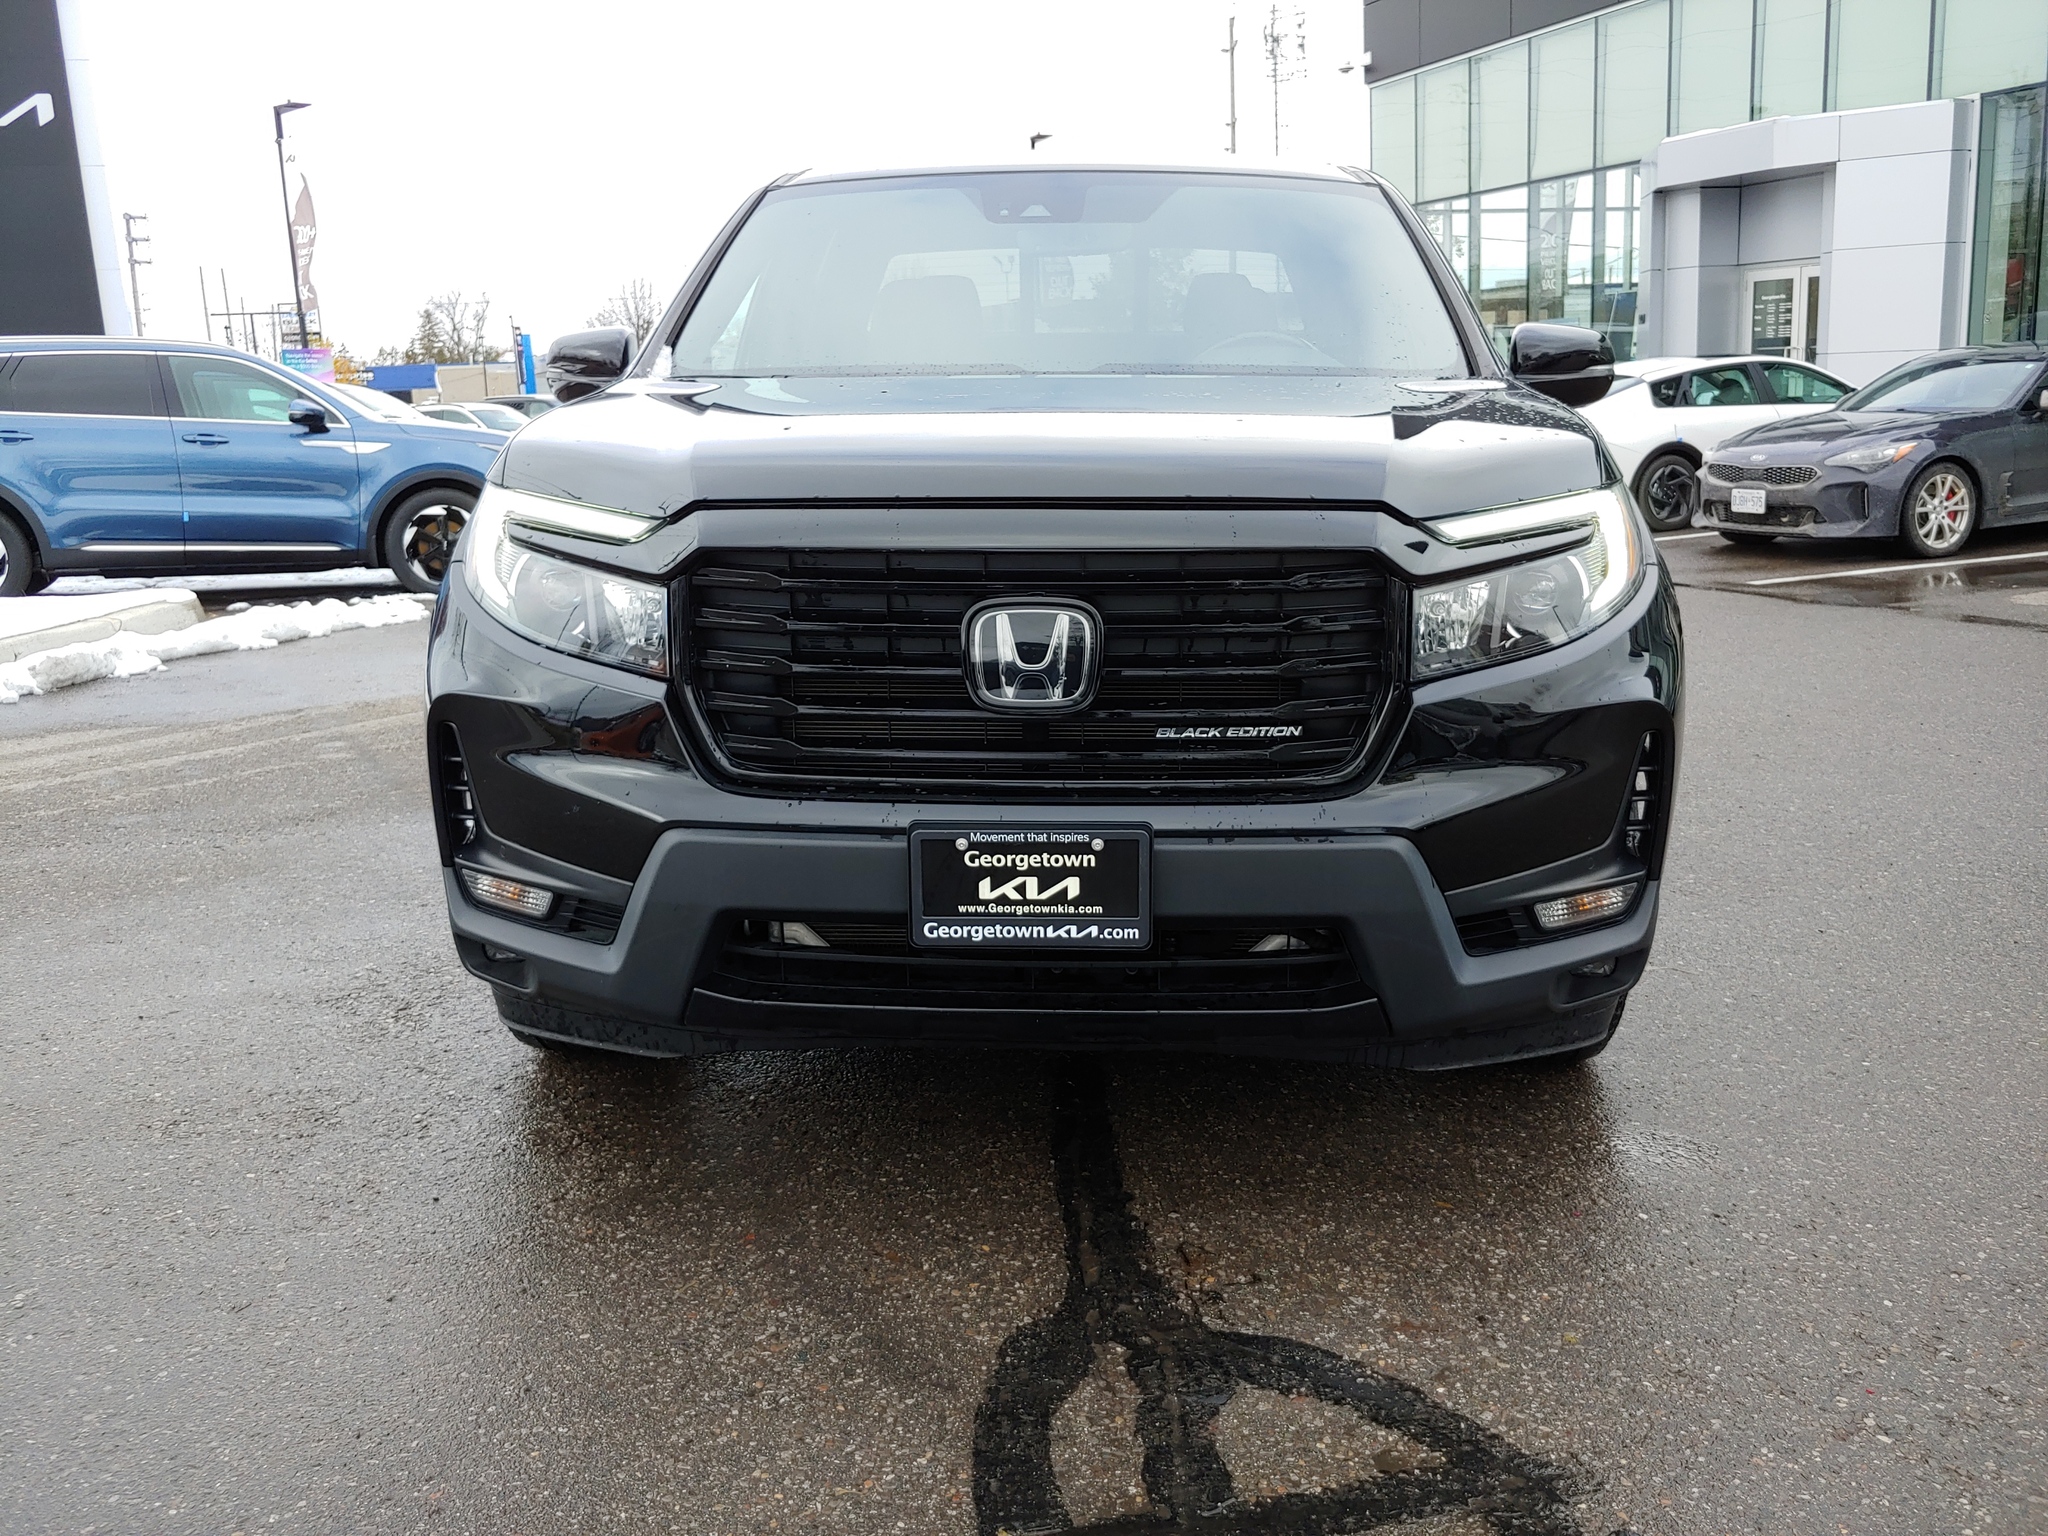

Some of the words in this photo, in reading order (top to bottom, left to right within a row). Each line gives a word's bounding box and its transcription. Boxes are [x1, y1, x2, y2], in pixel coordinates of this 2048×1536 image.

[1155, 727, 1224, 738] BLACK
[1226, 726, 1303, 737] EDITION
[970, 832, 1025, 842] Movement
[1027, 832, 1048, 842] that
[1050, 832, 1089, 844] inspires
[963, 850, 1096, 870] Georgetown
[957, 903, 1103, 915] www.Georgetownkia.com
